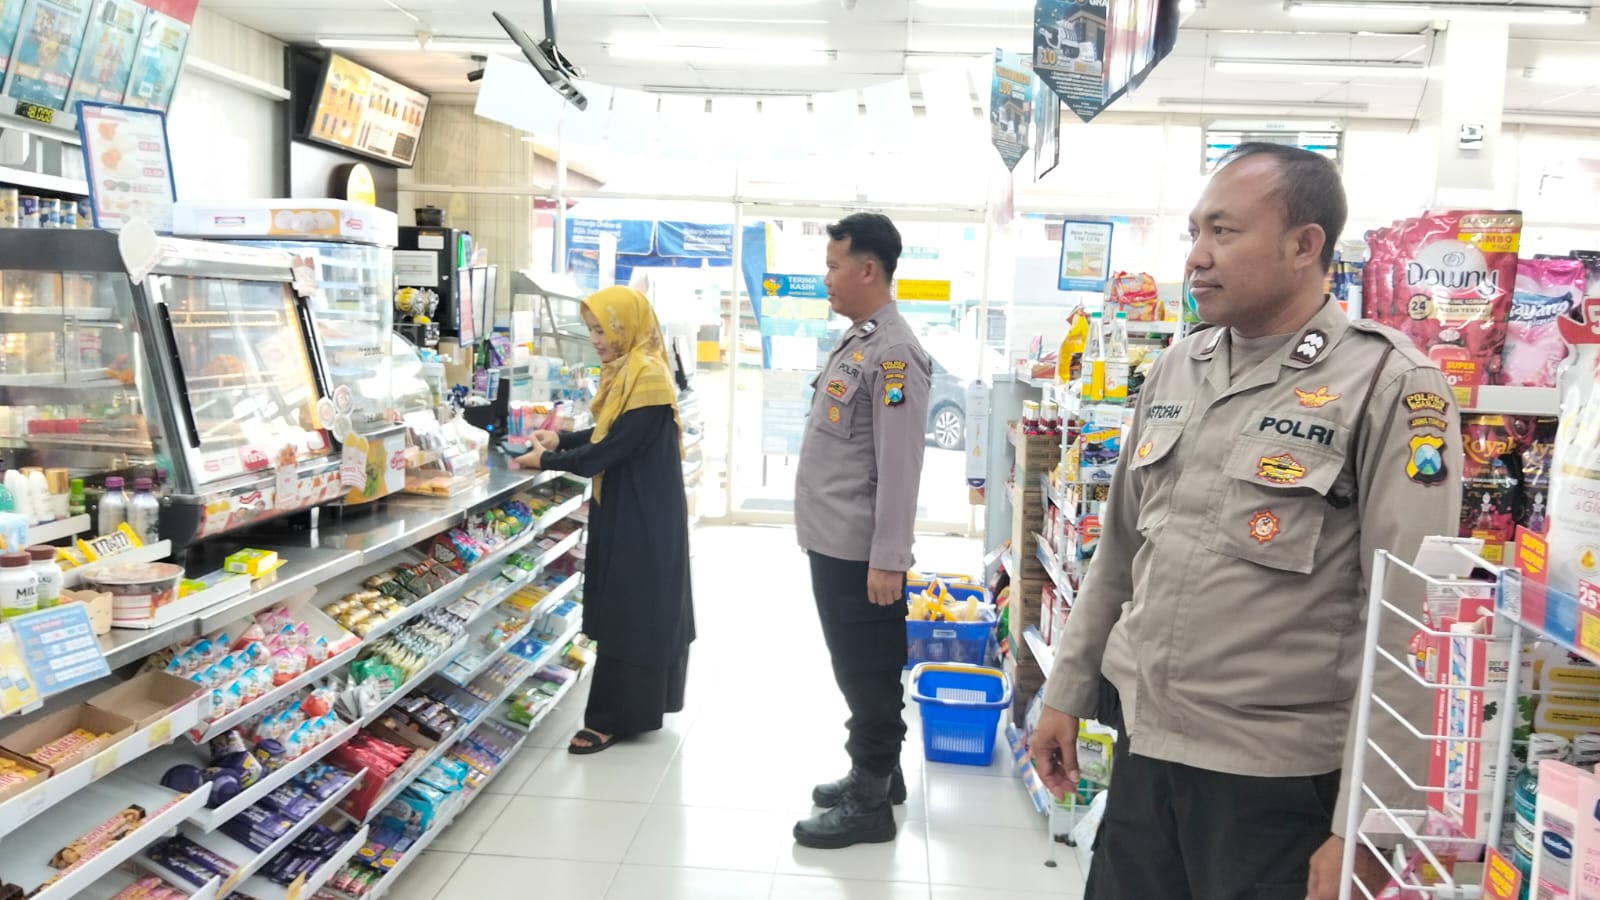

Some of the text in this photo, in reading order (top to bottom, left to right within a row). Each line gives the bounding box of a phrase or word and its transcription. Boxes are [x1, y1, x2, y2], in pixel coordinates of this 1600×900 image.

[788, 276, 817, 284] TERIMA
[1406, 262, 1499, 296] Downy
[790, 283, 815, 291] KASIH
[1411, 301, 1426, 311] 24
[839, 362, 860, 379] POLRI
[1259, 416, 1335, 446] POLRI
